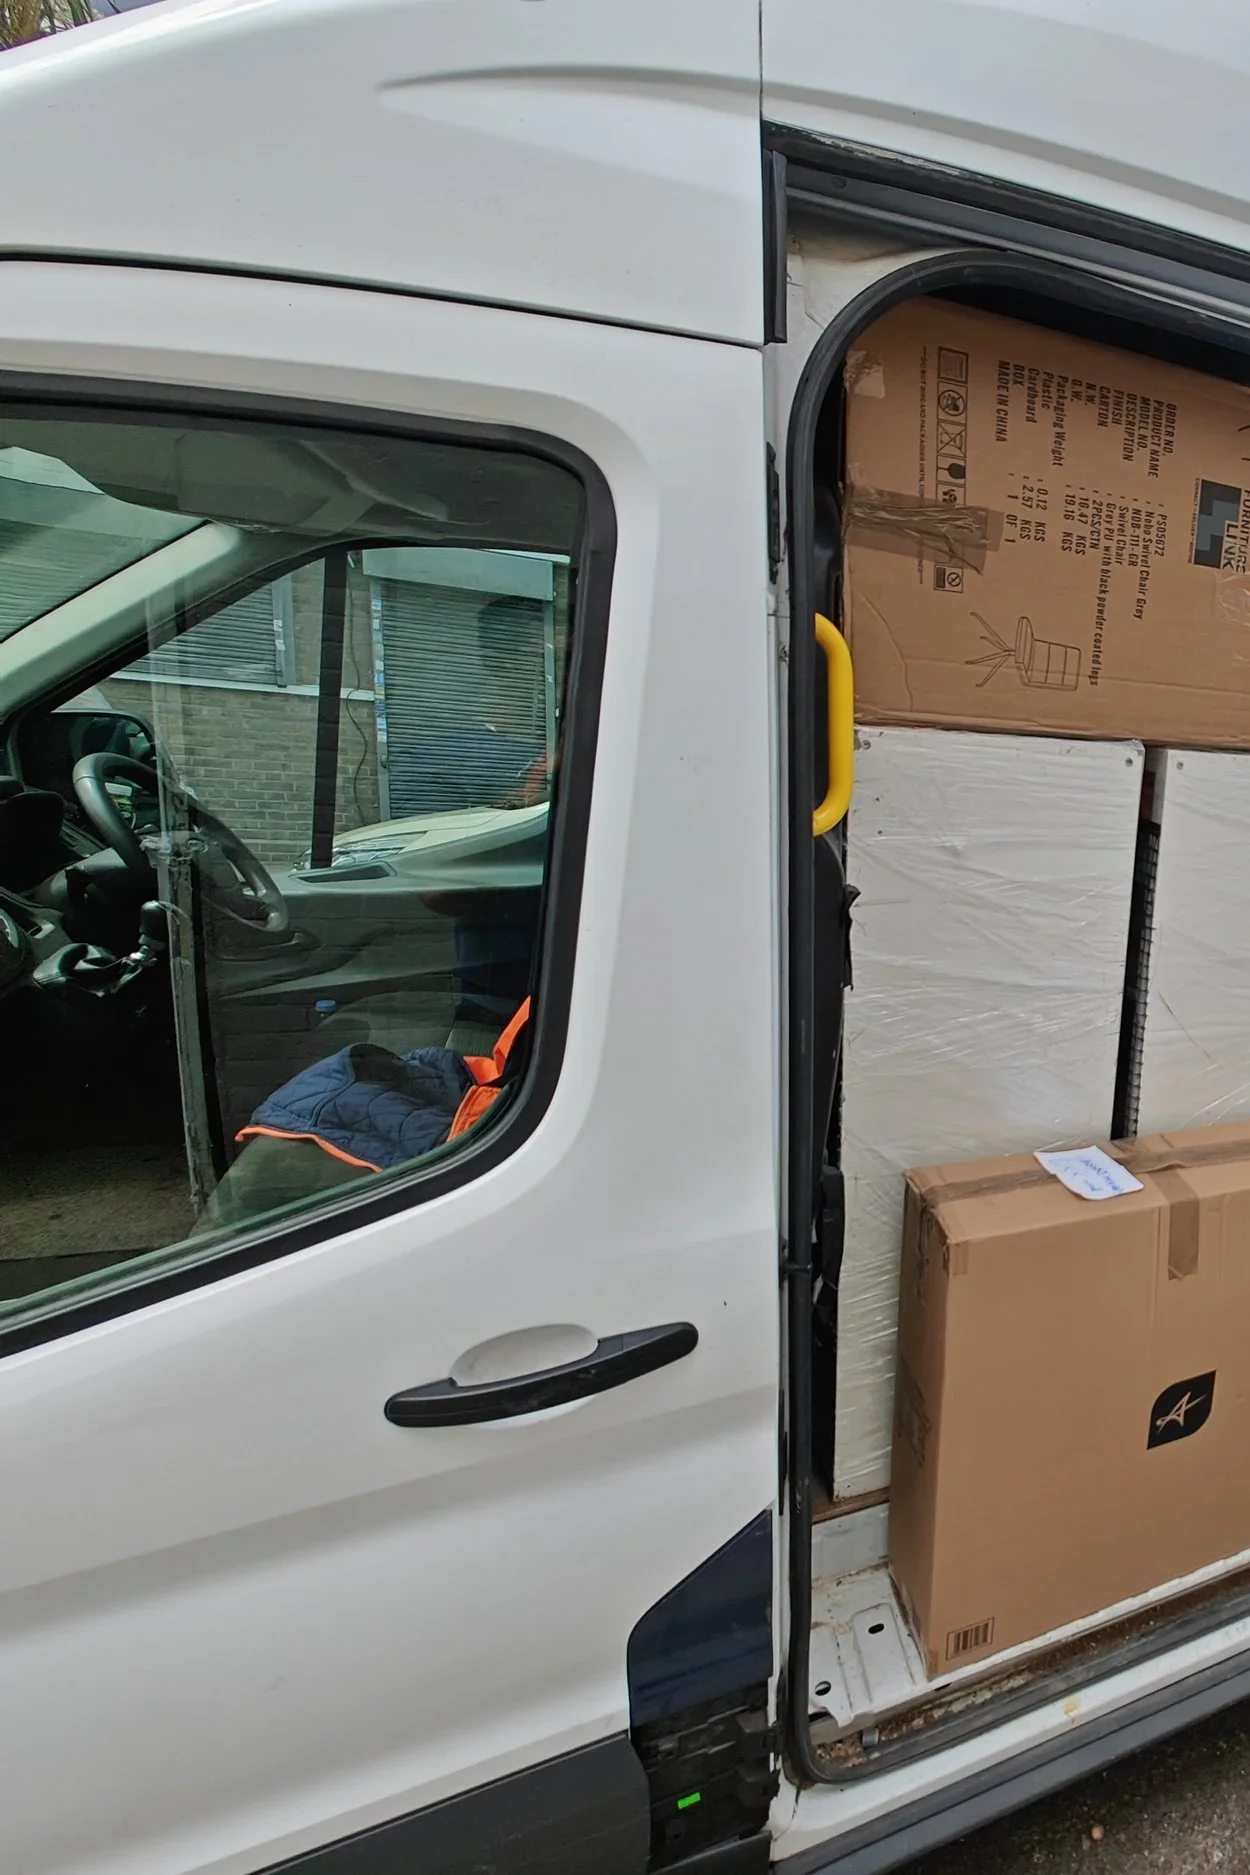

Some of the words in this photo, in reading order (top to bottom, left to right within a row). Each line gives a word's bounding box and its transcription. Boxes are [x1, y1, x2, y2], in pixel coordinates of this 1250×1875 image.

[997, 360, 1010, 392] MADE
[1013, 363, 1025, 387] BOX
[997, 394, 1009, 407] IN
[1026, 367, 1040, 424] Cardboard
[1041, 371, 1054, 410] Plastic
[1052, 375, 1069, 429] Packaging
[1070, 379, 1083, 402] G.W.
[1085, 382, 1097, 406] N.W.
[1097, 386, 1111, 427] CARTON
[1111, 389, 1124, 425] FINISH
[1137, 396, 1151, 431] MODEL
[995, 408, 1008, 442] CHINA
[1122, 393, 1137, 462] DESCRIPTION
[1150, 400, 1164, 448] PRODUCT
[1164, 403, 1177, 438] ORDER
[1051, 432, 1066, 466] Weight
[1136, 433, 1148, 451] NO.
[1162, 439, 1174, 456] NO.
[1147, 449, 1160, 478] NAME
[1021, 484, 1034, 509] 2.57
[1035, 488, 1048, 510] 0.12
[1064, 494, 1076, 521] 19.16
[1006, 514, 1018, 528] OF
[1077, 497, 1090, 525] 16.47
[1103, 503, 1117, 525] Grey
[1117, 506, 1129, 537] Swivel
[1143, 511, 1155, 536] Nobo
[1020, 519, 1032, 540] KGS
[1034, 521, 1046, 542] KGS
[1089, 500, 1103, 550] 2PCS/CTN
[1104, 527, 1115, 542] PU
[1061, 531, 1074, 552] KGS
[1075, 535, 1087, 556] KGS
[1115, 539, 1127, 566] Chair
[1140, 537, 1153, 568] Swivel
[1222, 523, 1239, 570] LINK
[1102, 545, 1113, 566] with
[1099, 568, 1111, 595] black
[1138, 570, 1150, 597] Chair
[1096, 596, 1107, 631] powder
[1133, 598, 1147, 620] Grey
[1092, 633, 1103, 665] coated
[1088, 666, 1102, 686] legs
